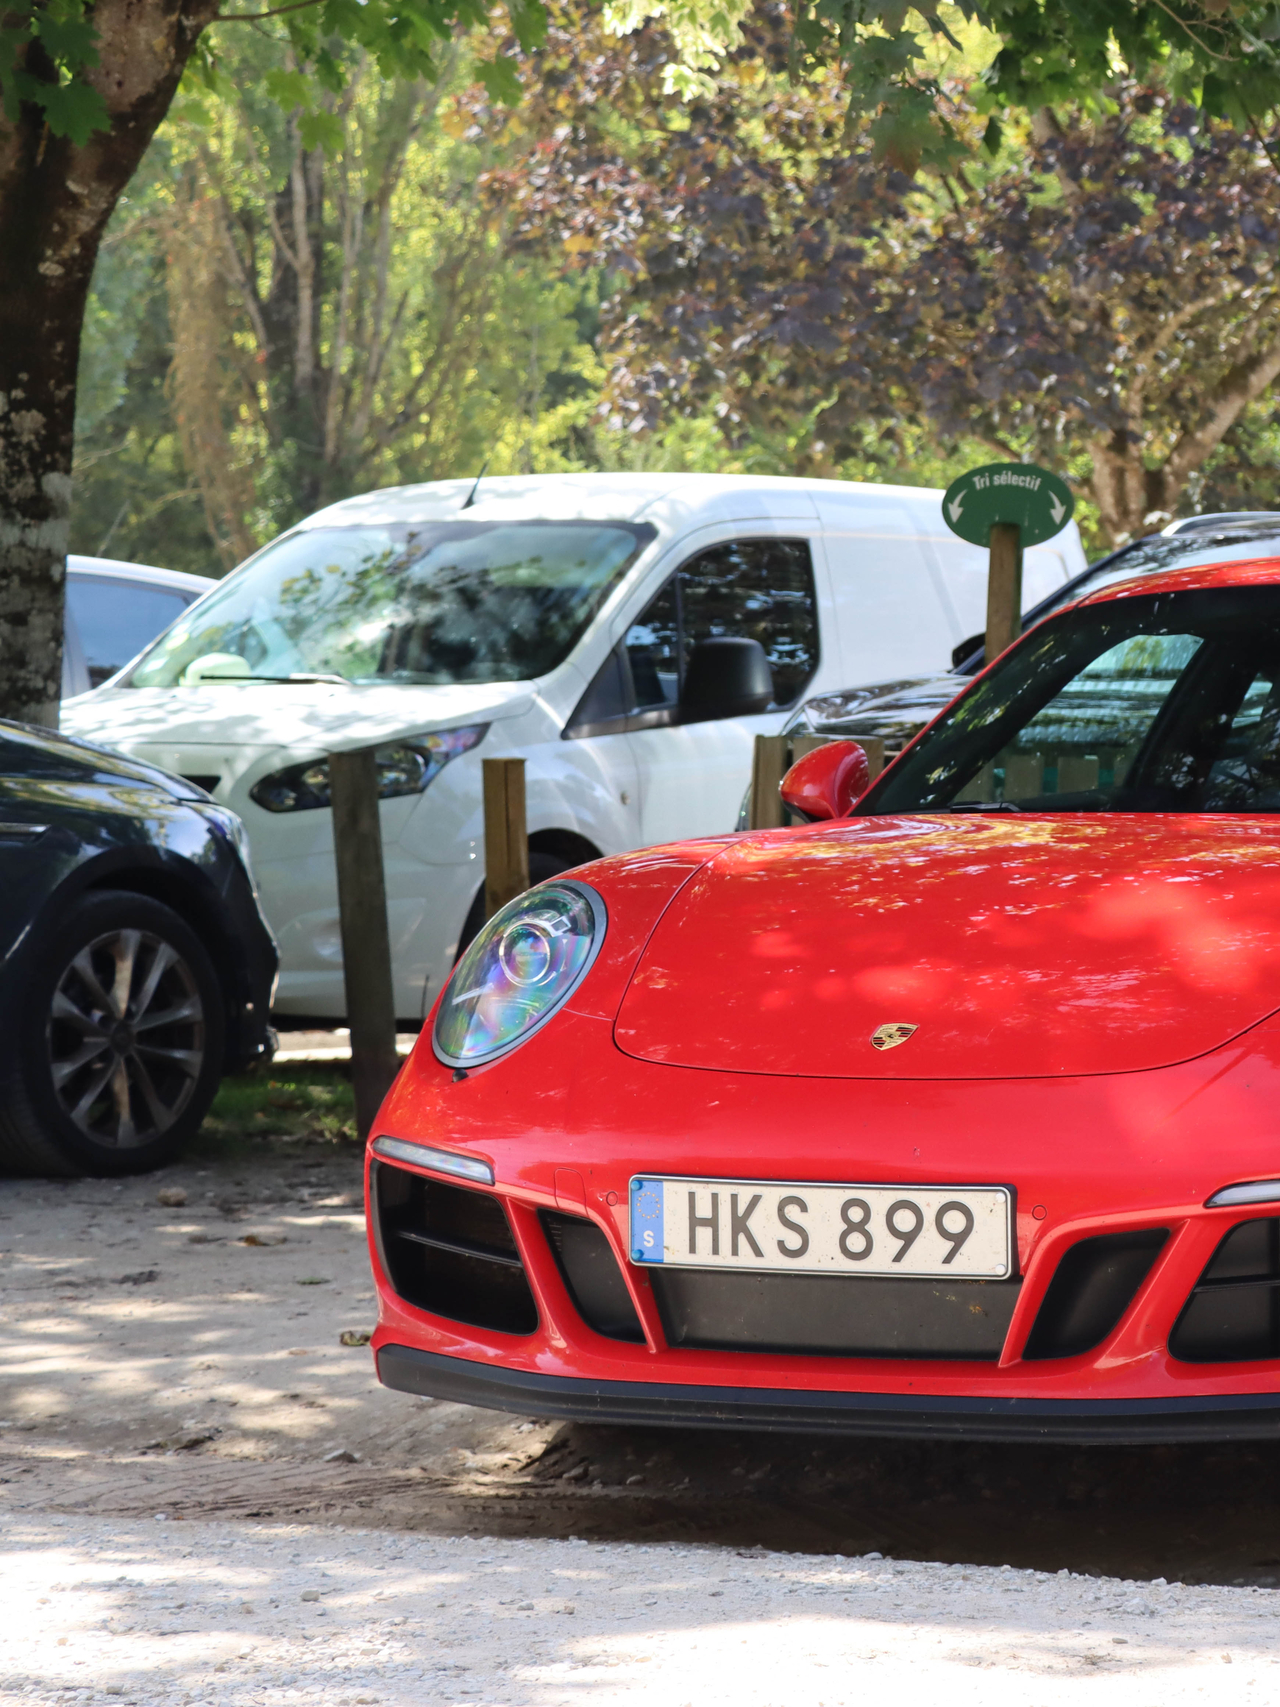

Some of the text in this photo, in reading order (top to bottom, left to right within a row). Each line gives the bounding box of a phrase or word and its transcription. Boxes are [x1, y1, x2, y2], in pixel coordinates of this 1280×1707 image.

[973, 470, 1041, 492] Tri sélectif
[643, 1230, 655, 1248] S
[688, 1191, 975, 1265] HKS 899
